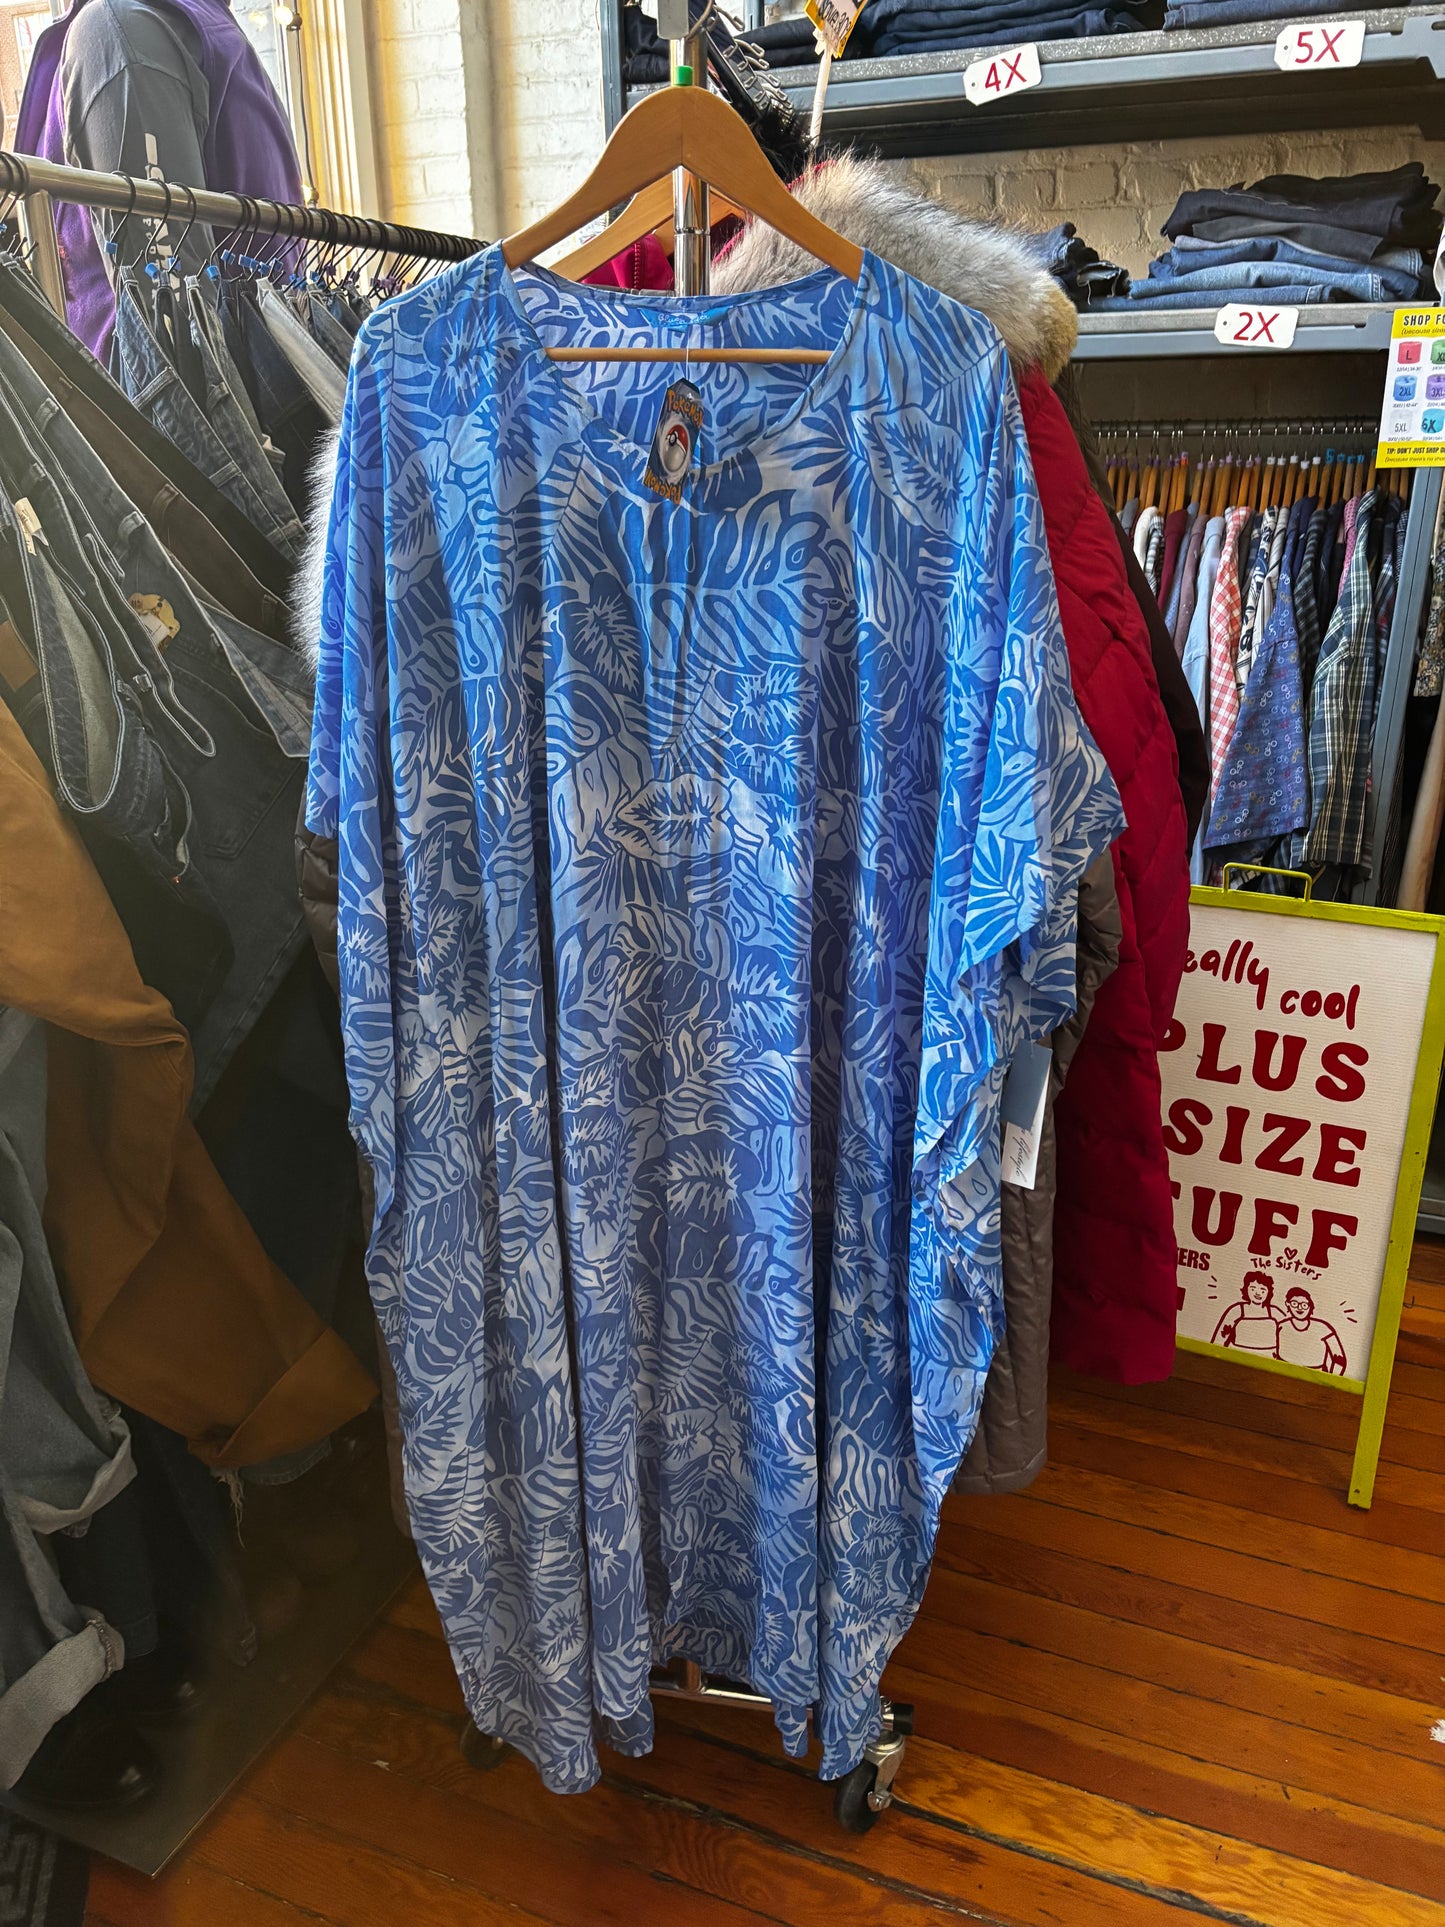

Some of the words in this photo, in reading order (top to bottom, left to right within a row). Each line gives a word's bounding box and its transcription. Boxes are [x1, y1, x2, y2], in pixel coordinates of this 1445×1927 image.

[1294, 29, 1346, 64] 5X
[985, 52, 1027, 92] 4X
[1233, 311, 1280, 343] 2X
[1403, 314, 1431, 326] SHOP
[1406, 350, 1412, 361] L
[1399, 386, 1411, 396] 2XL
[1394, 422, 1407, 433] 5XL
[1183, 939, 1270, 1011] eally
[1280, 984, 1361, 1031] cool
[1162, 1098, 1368, 1188] SIZE
[1171, 1181, 1359, 1269] UFF
[1250, 1257, 1272, 1270] The
[1275, 1255, 1323, 1281] Sisters
